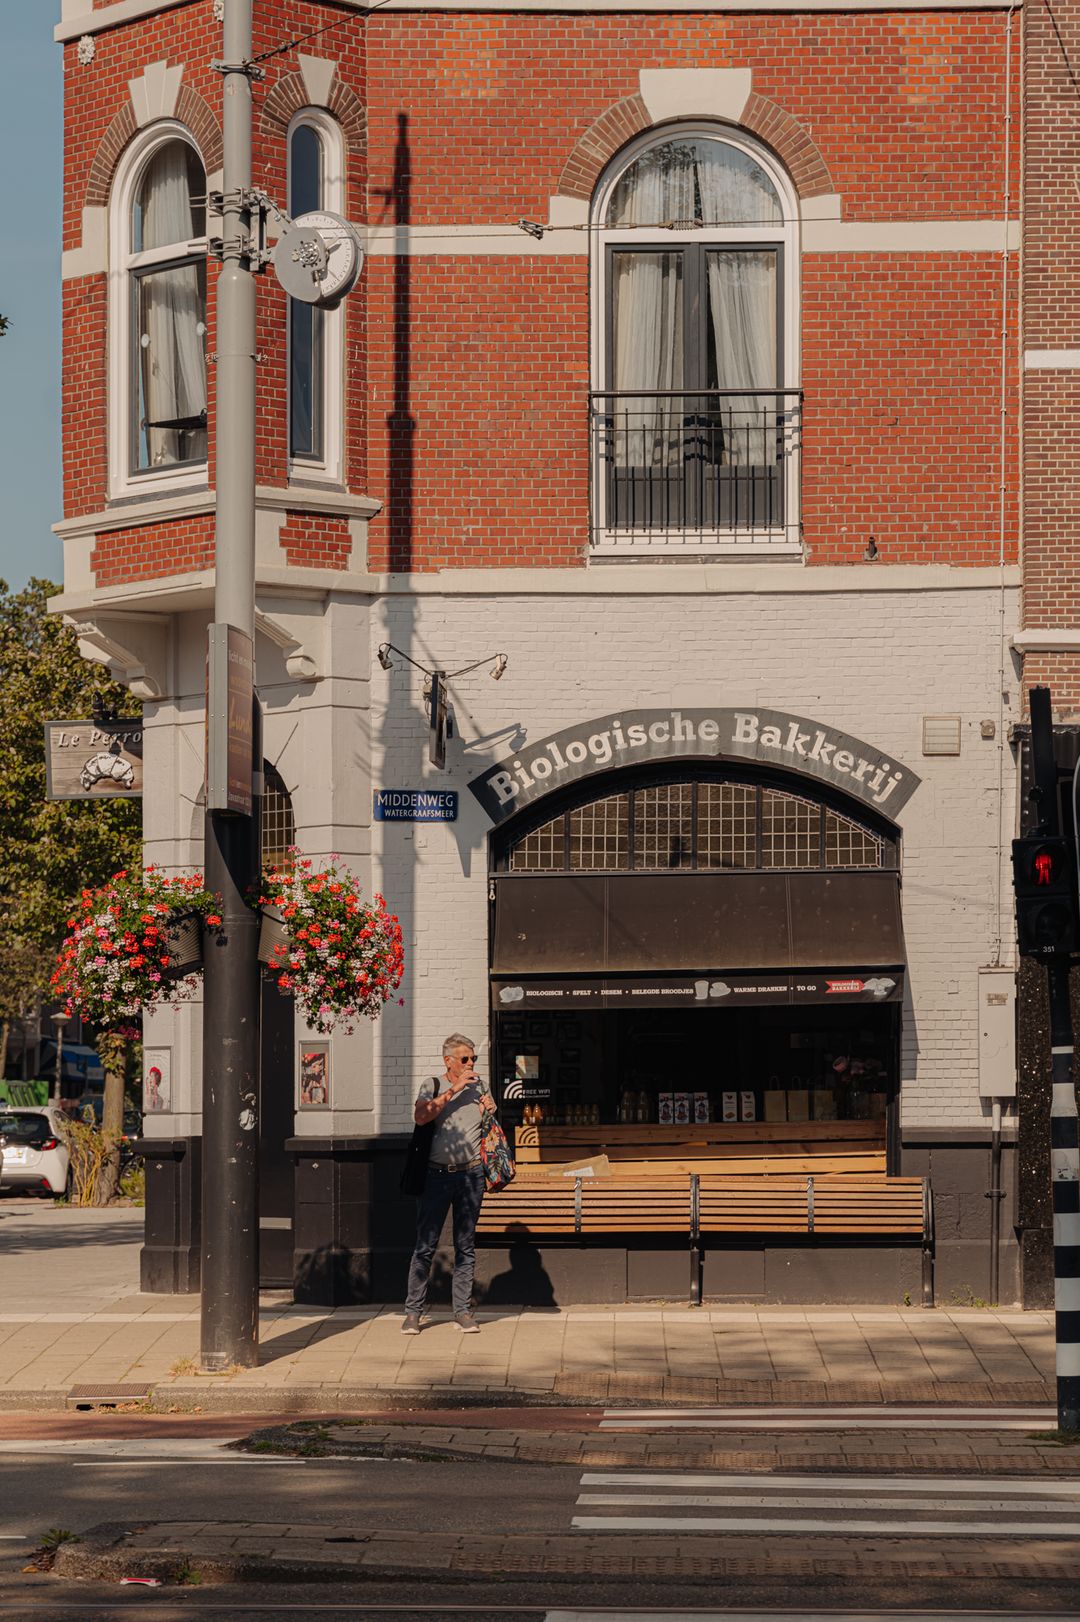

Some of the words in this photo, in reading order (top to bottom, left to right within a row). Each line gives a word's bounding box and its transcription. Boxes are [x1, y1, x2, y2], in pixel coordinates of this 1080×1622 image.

[58, 731, 80, 747] Le
[486, 711, 720, 806] Biologische
[731, 712, 903, 803] Bakkerij
[377, 793, 454, 807] MIDDENWEG
[384, 809, 454, 818] WATERGRAAFSMEER
[1042, 945, 1055, 953] 351
[757, 985, 788, 993] DRANKEN
